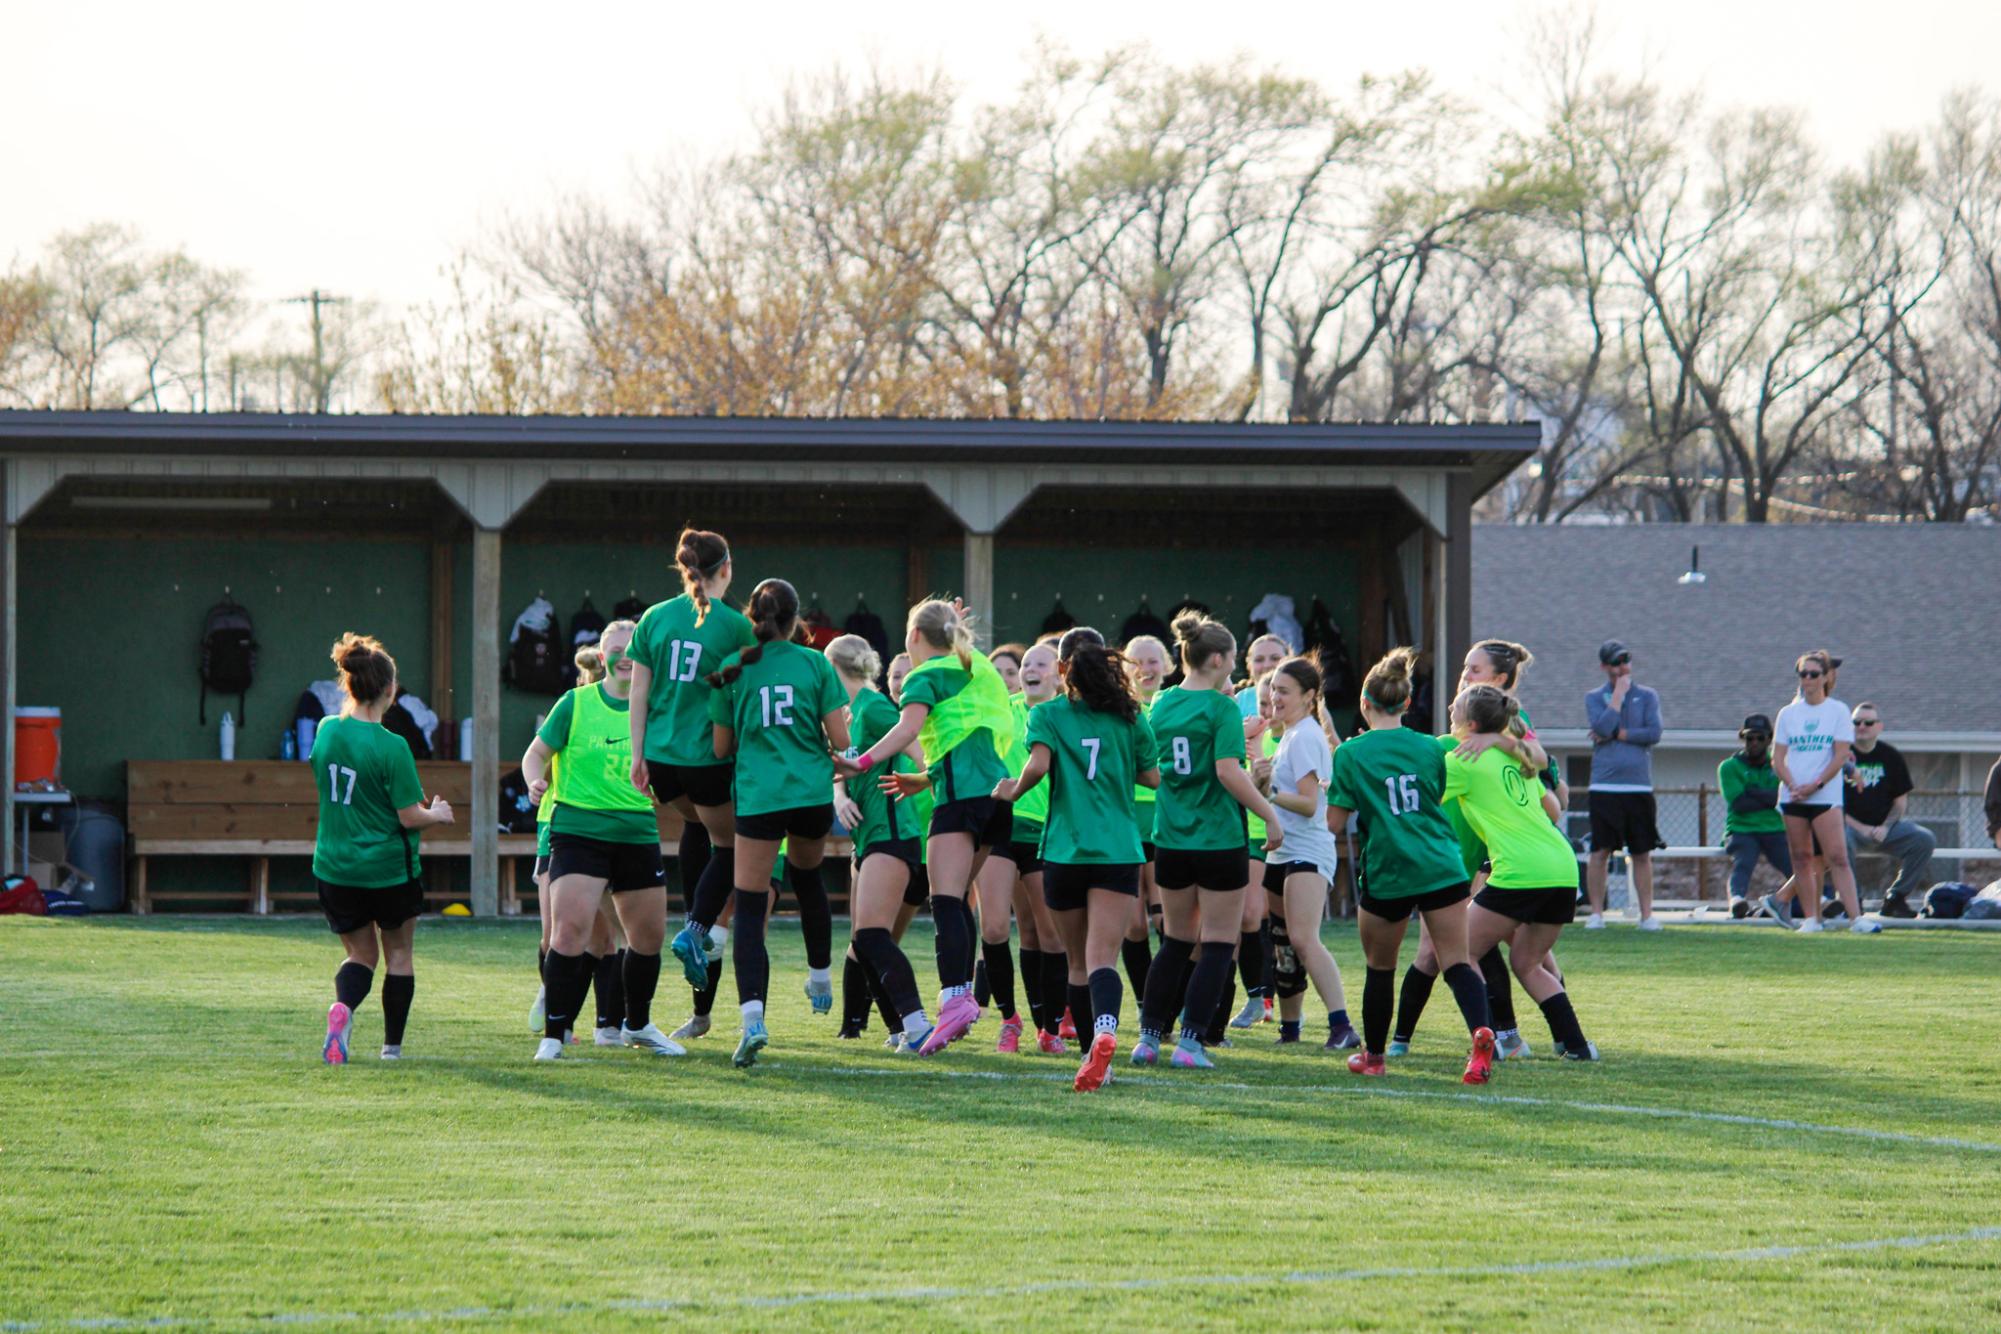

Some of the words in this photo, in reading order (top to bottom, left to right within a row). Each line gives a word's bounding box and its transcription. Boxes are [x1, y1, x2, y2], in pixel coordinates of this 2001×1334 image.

[668, 639, 703, 683] 13
[759, 684, 794, 728] 12
[1081, 737, 1101, 781] 7
[1172, 736, 1192, 776] 8
[328, 763, 357, 805] 17
[1385, 773, 1420, 816] 16
